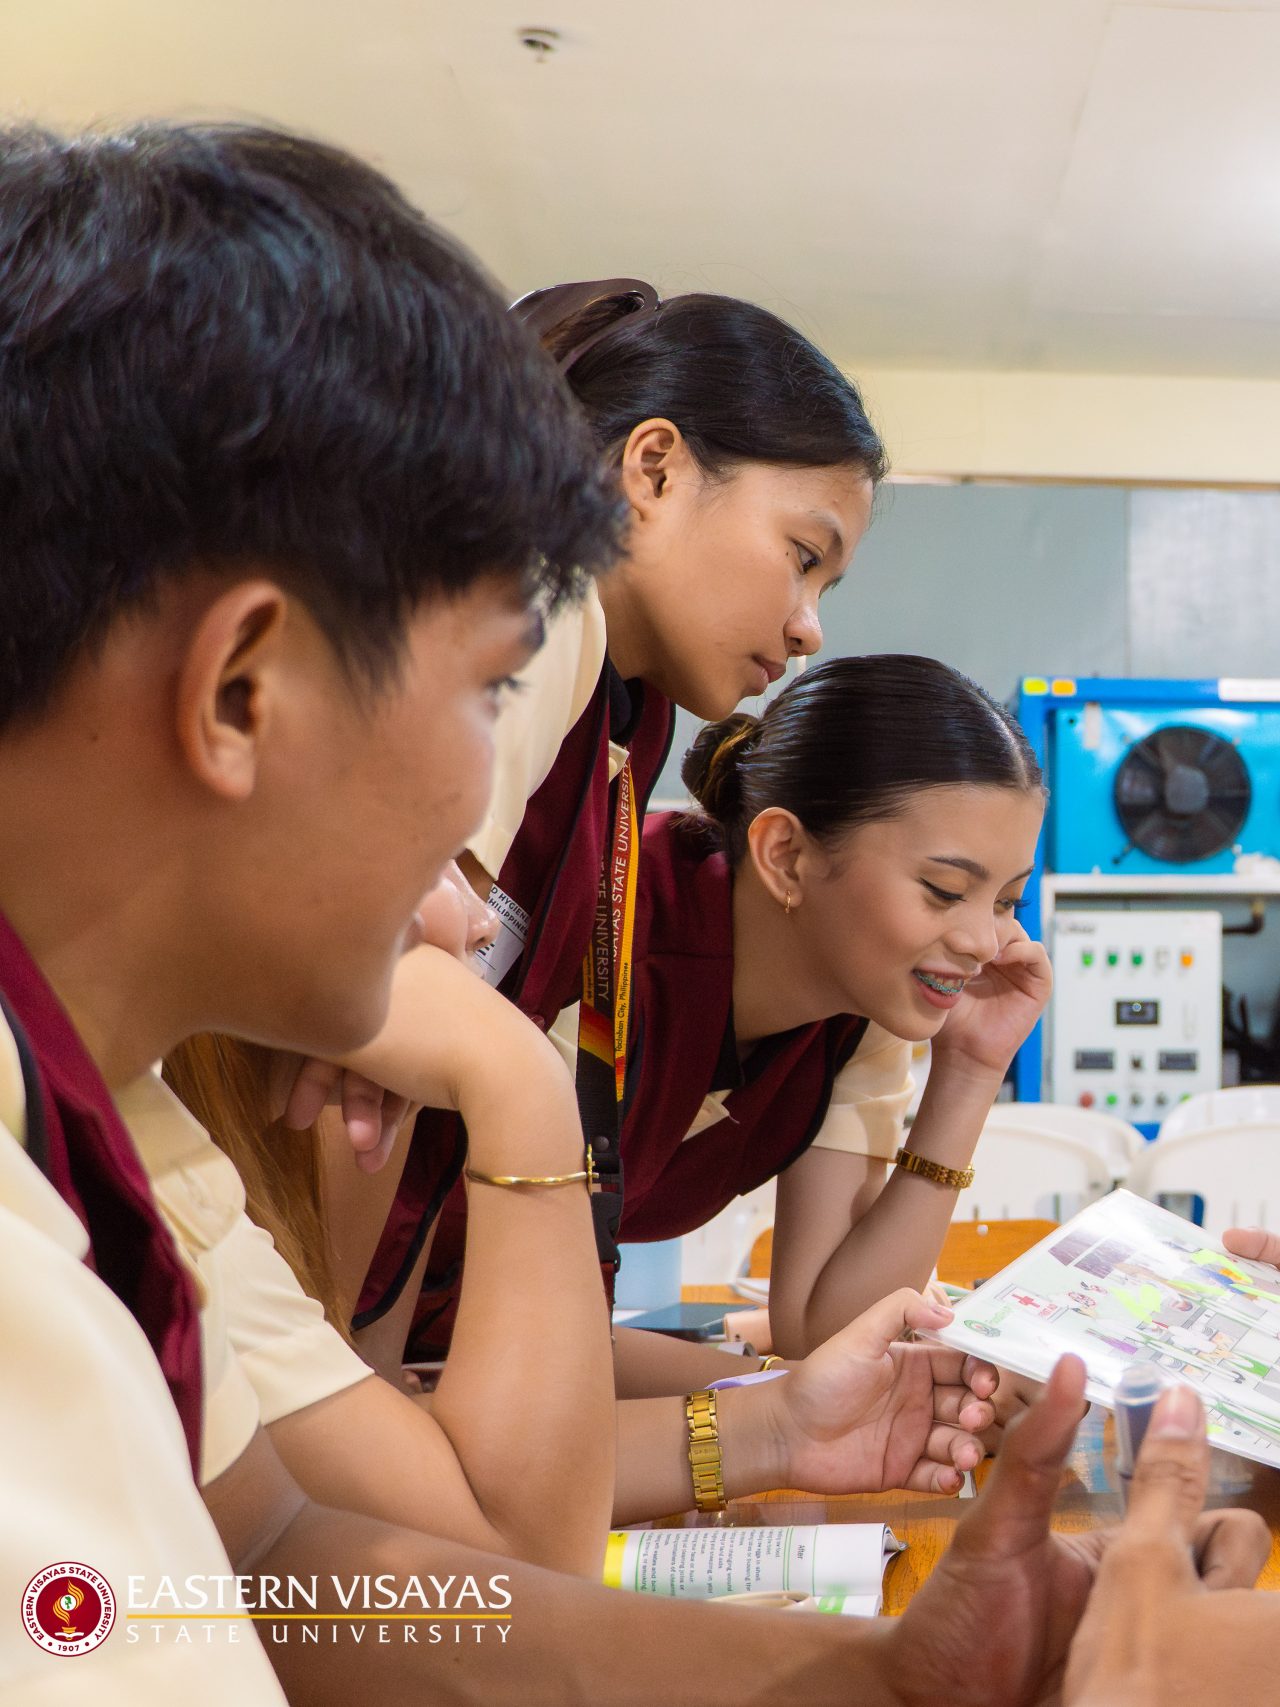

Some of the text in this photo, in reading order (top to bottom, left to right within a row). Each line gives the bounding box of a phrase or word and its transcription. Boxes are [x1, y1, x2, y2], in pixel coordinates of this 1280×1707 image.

[617, 762, 630, 852] UNIVERSITY
[612, 856, 627, 903] STATE
[487, 897, 529, 936] HILIPPINES
[595, 906, 609, 1001] UNIVERSITY
[796, 1544, 805, 1560] After
